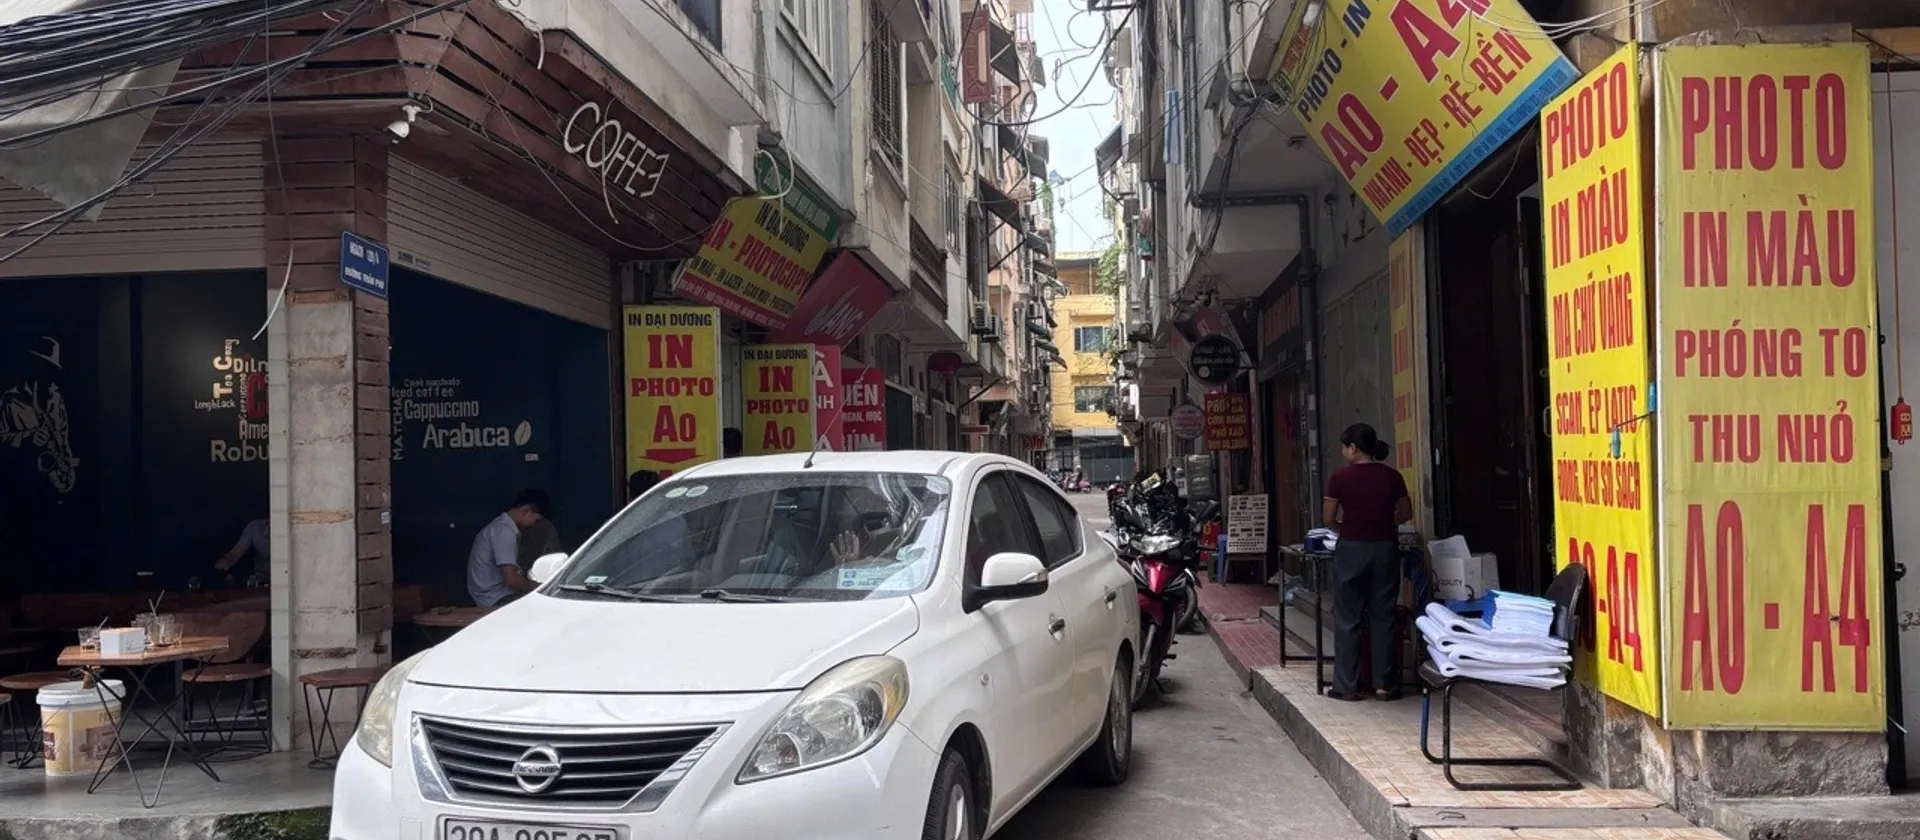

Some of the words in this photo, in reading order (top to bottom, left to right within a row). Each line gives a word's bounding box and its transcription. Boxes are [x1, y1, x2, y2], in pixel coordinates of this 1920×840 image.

[1297, 48, 1342, 123] PHOTO
[1342, 0, 1372, 38] IN
[1363, 156, 1412, 212] NHANH
[1404, 117, 1445, 168] ĐẸP
[1439, 73, 1483, 128] RẺ
[1545, 61, 1628, 179] PHOTO
[1681, 73, 1847, 171] PHOTO
[1551, 197, 1571, 269] IN
[1577, 165, 1628, 258] MÀU
[1683, 211, 1728, 288] IN
[1746, 194, 1856, 288] MÀU
[734, 233, 813, 297] PHOTOCOPY
[628, 314, 641, 326] IN
[646, 314, 666, 329] ĐẠI
[670, 313, 712, 327] DƯƠNG
[1553, 292, 1572, 373] MẠ
[1573, 271, 1597, 356] CHỮ
[1599, 265, 1634, 350] VÀNG
[1675, 319, 1802, 378] PHÓNG
[1819, 327, 1867, 378] TO
[648, 334, 693, 369] IN
[759, 366, 793, 393] IN
[404, 399, 479, 422] Cappuccino
[631, 376, 714, 397] PHOTO
[747, 398, 809, 415] PHOTO
[1588, 380, 1602, 435] ÉP
[422, 421, 510, 449] Arabica
[1688, 414, 1761, 463] THU
[1778, 399, 1854, 463] NHỎ
[1615, 452, 1641, 511] SÁCH
[1801, 503, 1871, 693] A4
